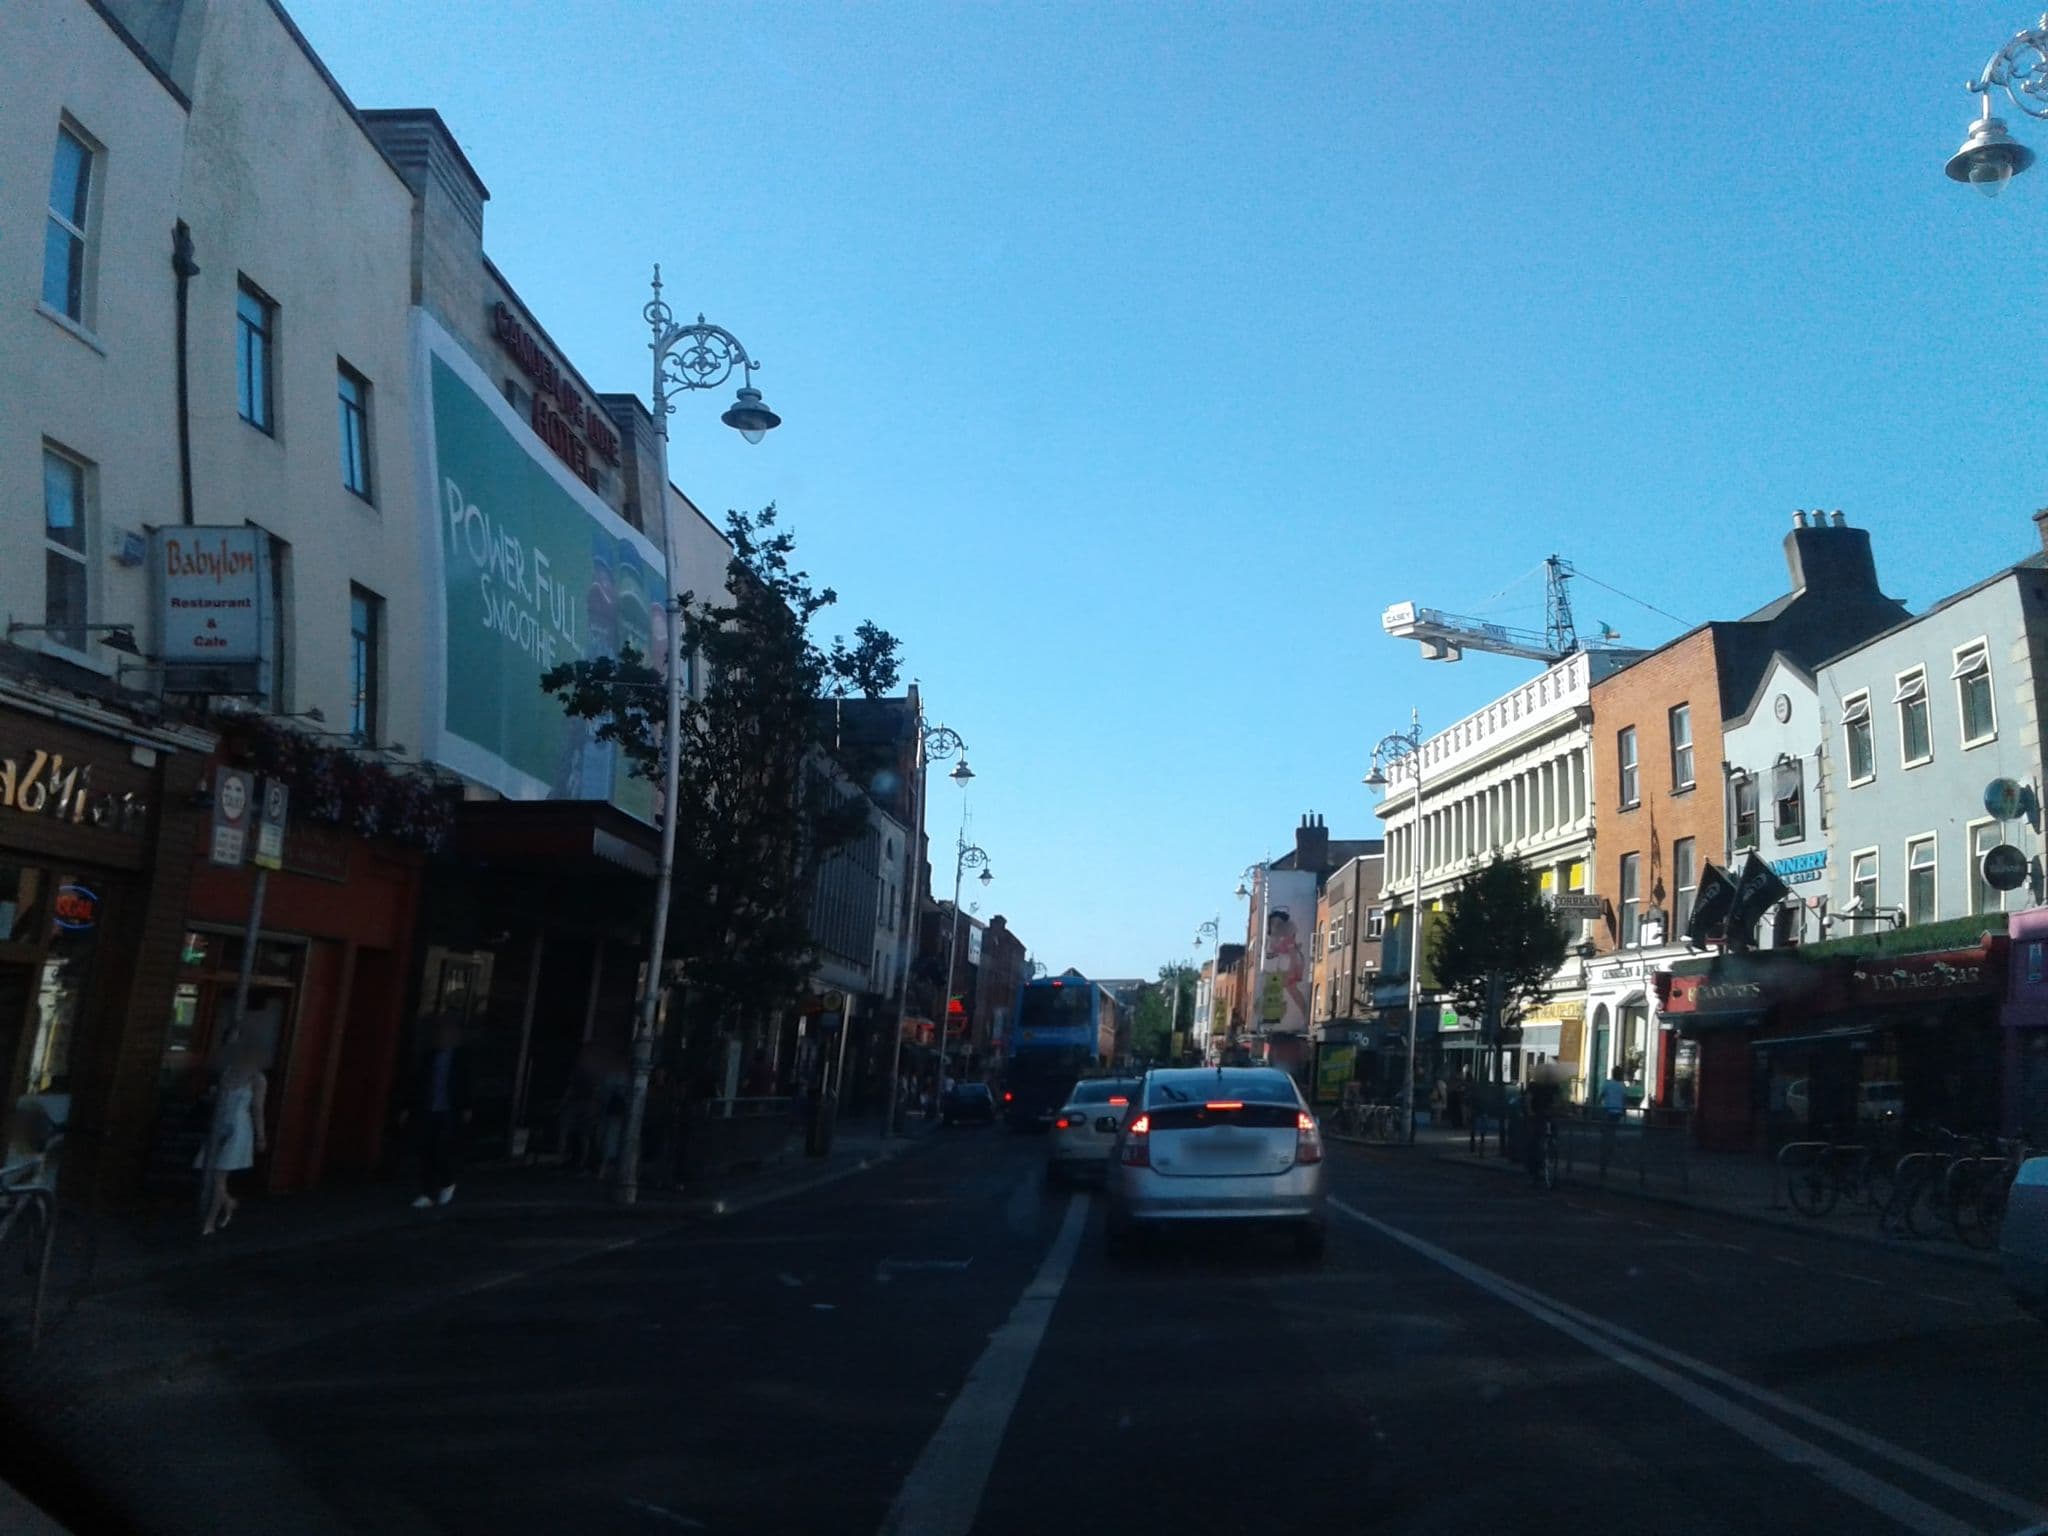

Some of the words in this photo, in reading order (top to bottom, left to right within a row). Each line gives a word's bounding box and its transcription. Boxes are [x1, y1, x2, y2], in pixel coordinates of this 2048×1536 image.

[167, 538, 253, 584] Babylon
[171, 597, 251, 609] Restaurant
[207, 618, 217, 629] &
